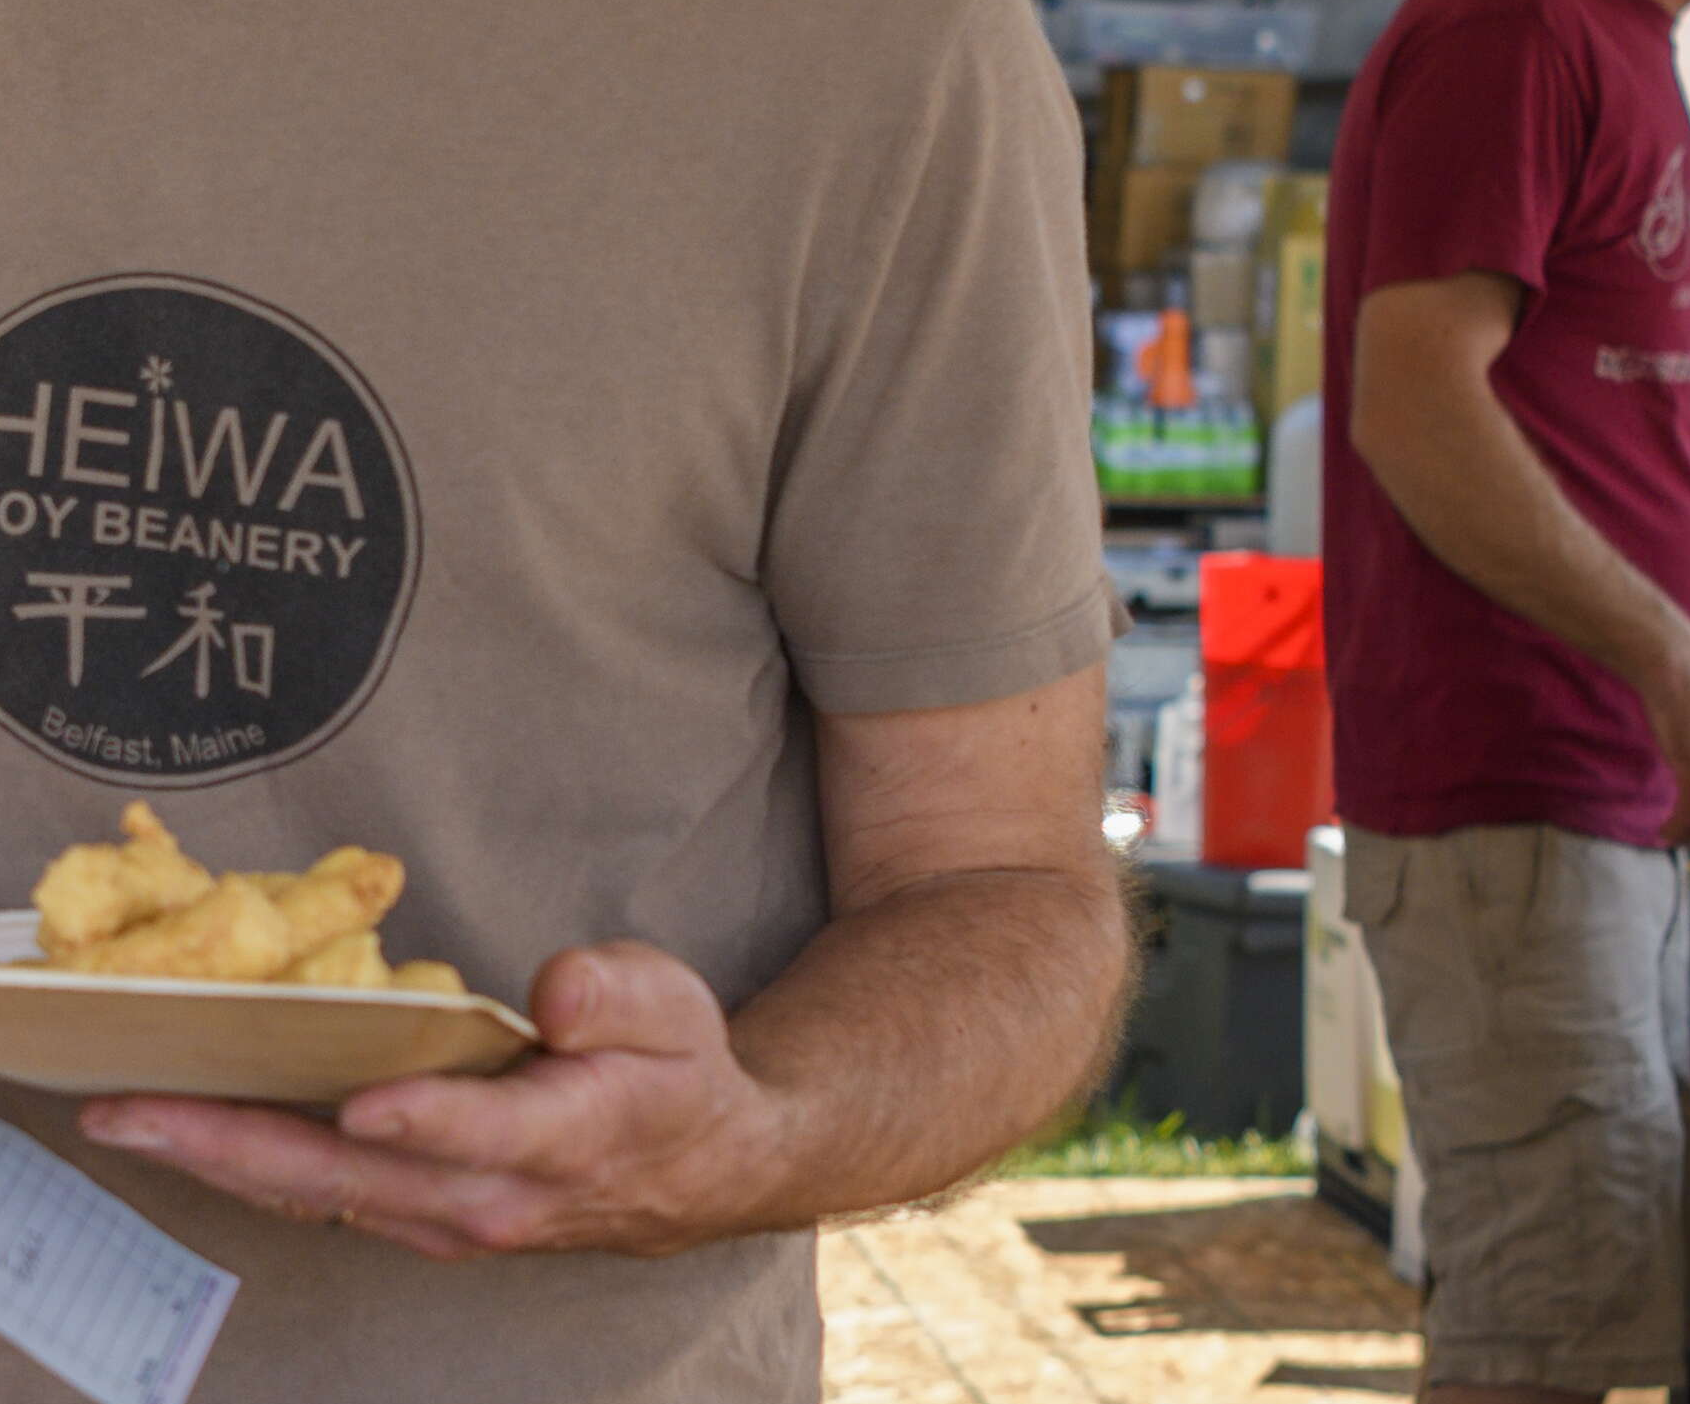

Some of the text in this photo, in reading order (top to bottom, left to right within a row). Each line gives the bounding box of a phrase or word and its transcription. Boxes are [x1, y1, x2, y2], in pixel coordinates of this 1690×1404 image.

[92, 501, 368, 581] BEANERY
[11, 571, 276, 700] 平和
[40, 703, 268, 769] Belfast, Maine
